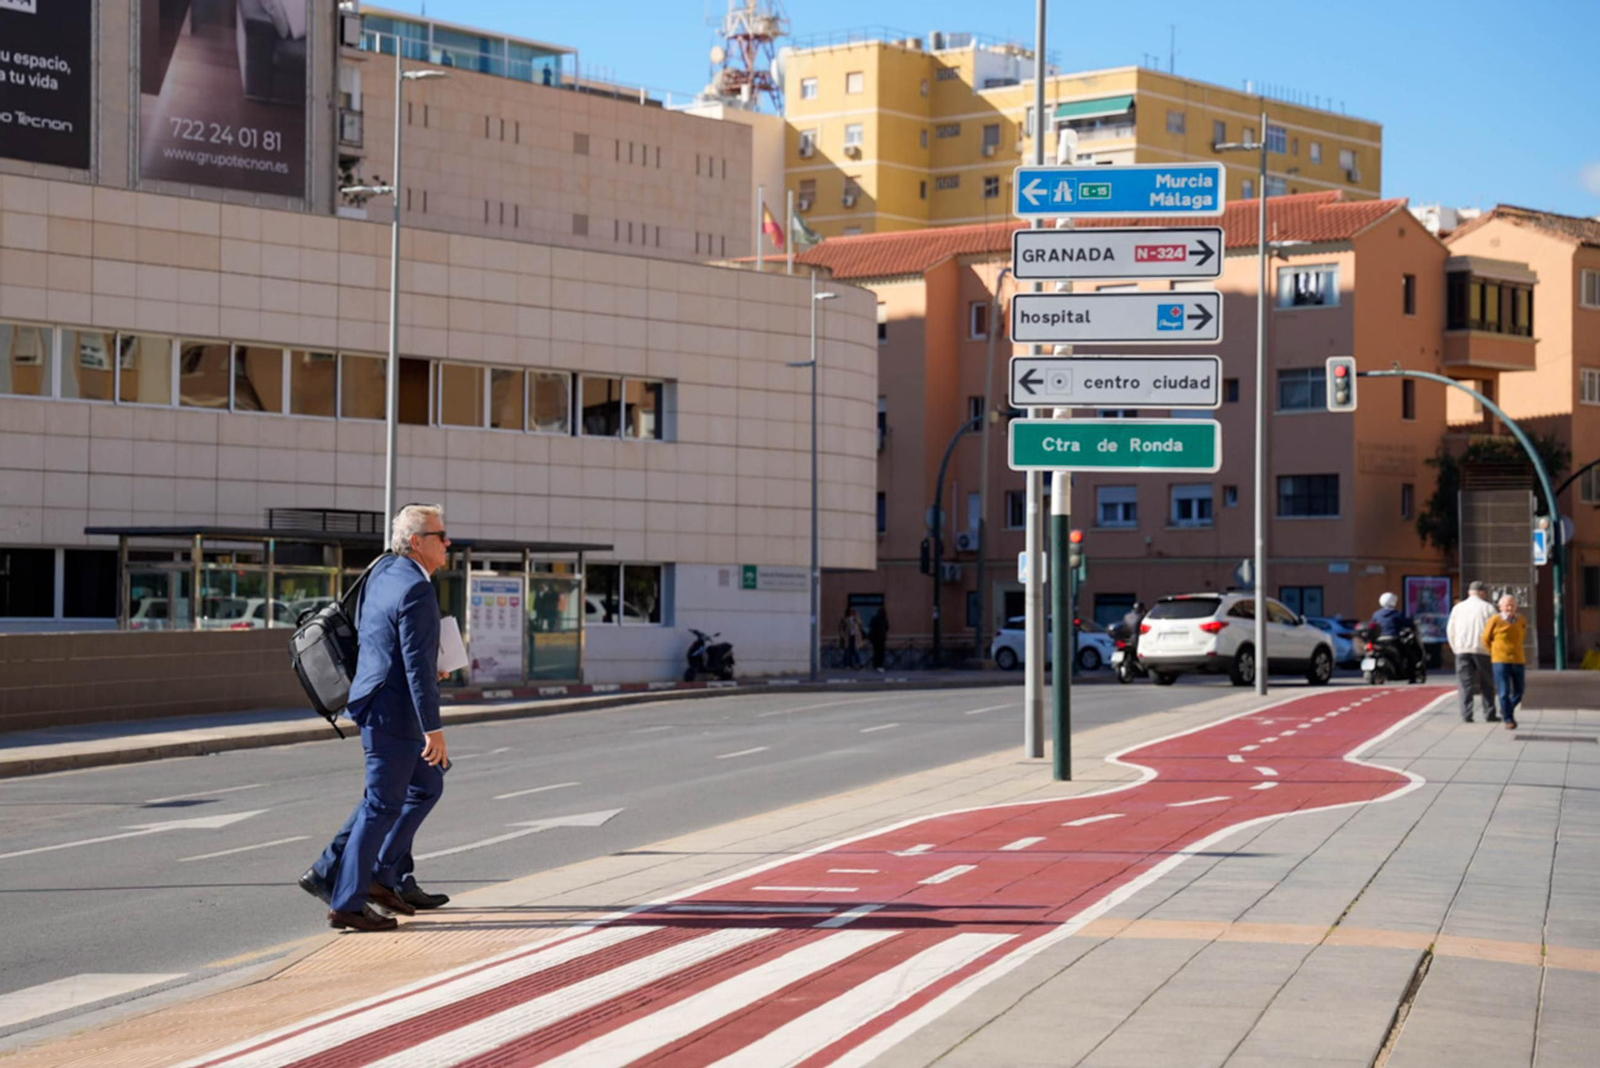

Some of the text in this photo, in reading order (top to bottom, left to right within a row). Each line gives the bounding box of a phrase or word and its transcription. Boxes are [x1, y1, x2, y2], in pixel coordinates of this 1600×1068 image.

[13, 52, 71, 76] espacio,
[9, 69, 25, 85] tu
[28, 72, 58, 90] vida
[170, 117, 281, 152] 722 24 01 81
[163, 148, 289, 174] www.grupotecnon.es
[1155, 173, 1213, 188] Murcia
[1150, 192, 1213, 209] Málaga
[1022, 247, 1115, 263] GRANADA
[1020, 310, 1091, 326] hospital
[1083, 375, 1211, 389] centro ciudad
[1042, 437, 1183, 452] Ctra de Ronda
